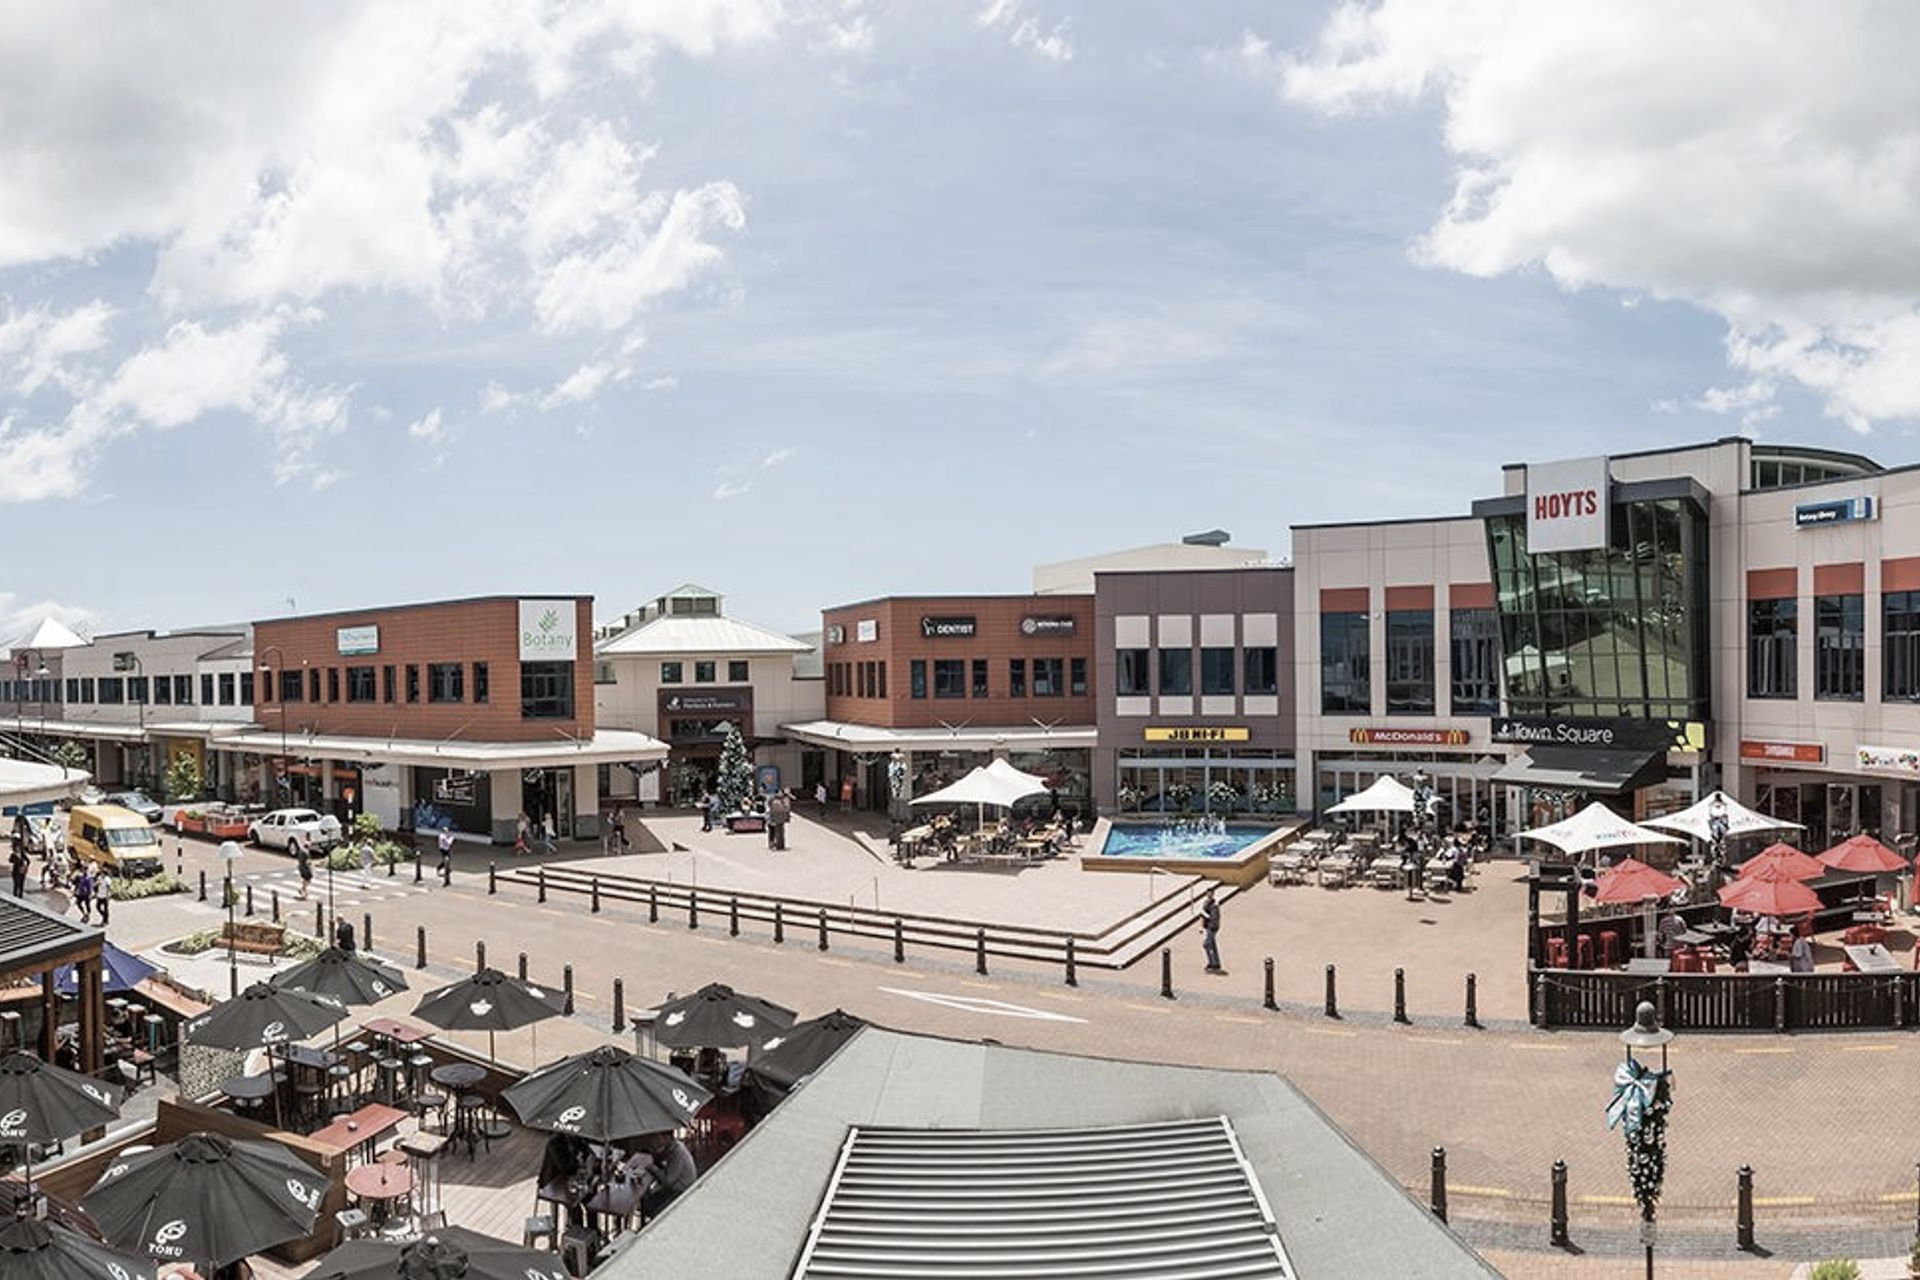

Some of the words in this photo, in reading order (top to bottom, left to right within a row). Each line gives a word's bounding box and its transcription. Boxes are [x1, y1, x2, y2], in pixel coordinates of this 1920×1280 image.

[1534, 490, 1597, 520] HOYTS
[936, 624, 974, 635] DENTIST
[523, 631, 573, 649] Botany
[1374, 731, 1442, 742] McDonald's
[1512, 722, 1551, 741] Town
[1556, 723, 1614, 745] Square
